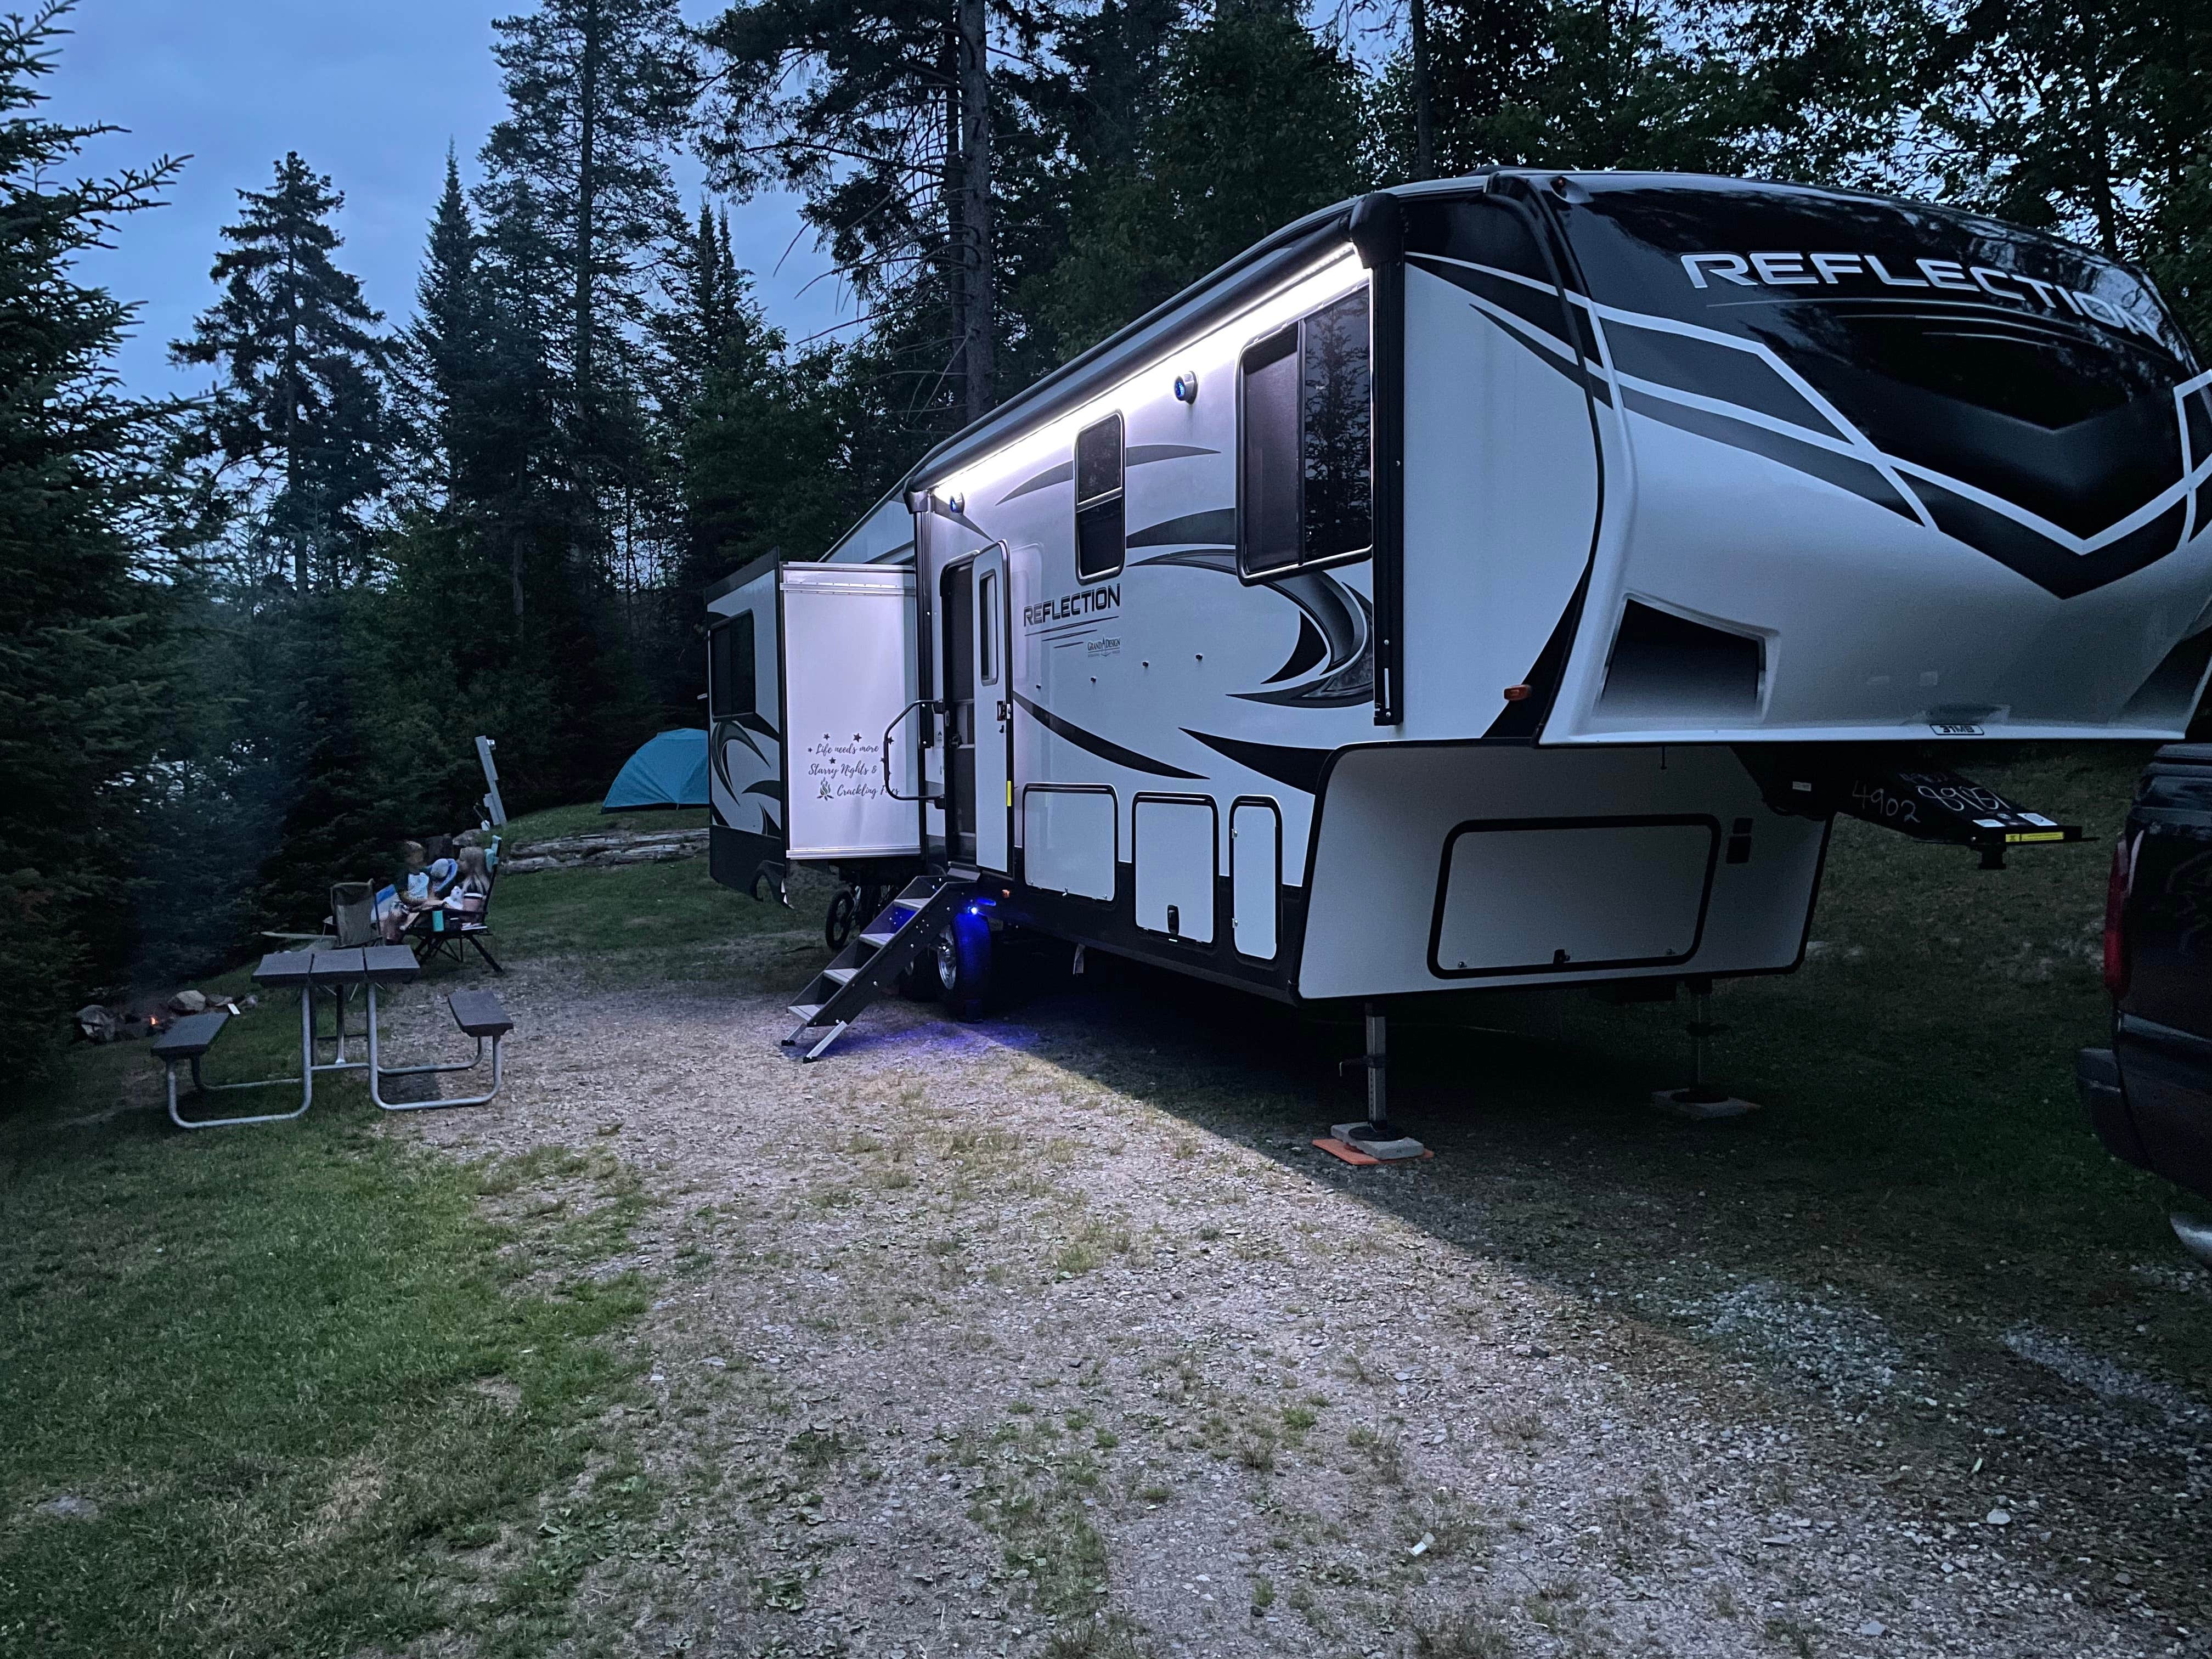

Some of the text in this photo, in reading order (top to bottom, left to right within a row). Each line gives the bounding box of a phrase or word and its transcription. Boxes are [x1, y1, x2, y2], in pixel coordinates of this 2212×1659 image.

[1680, 251, 2166, 348] REFLECTION
[1023, 583, 1120, 627] REFLECTION
[1087, 638, 1121, 651] GRAND DESIGN
[815, 743, 832, 756] Life
[835, 744, 857, 754] needs
[808, 760, 877, 778] Starry Nights &
[837, 784, 900, 799] Crackling Fes
[1852, 780, 1921, 823] 4902
